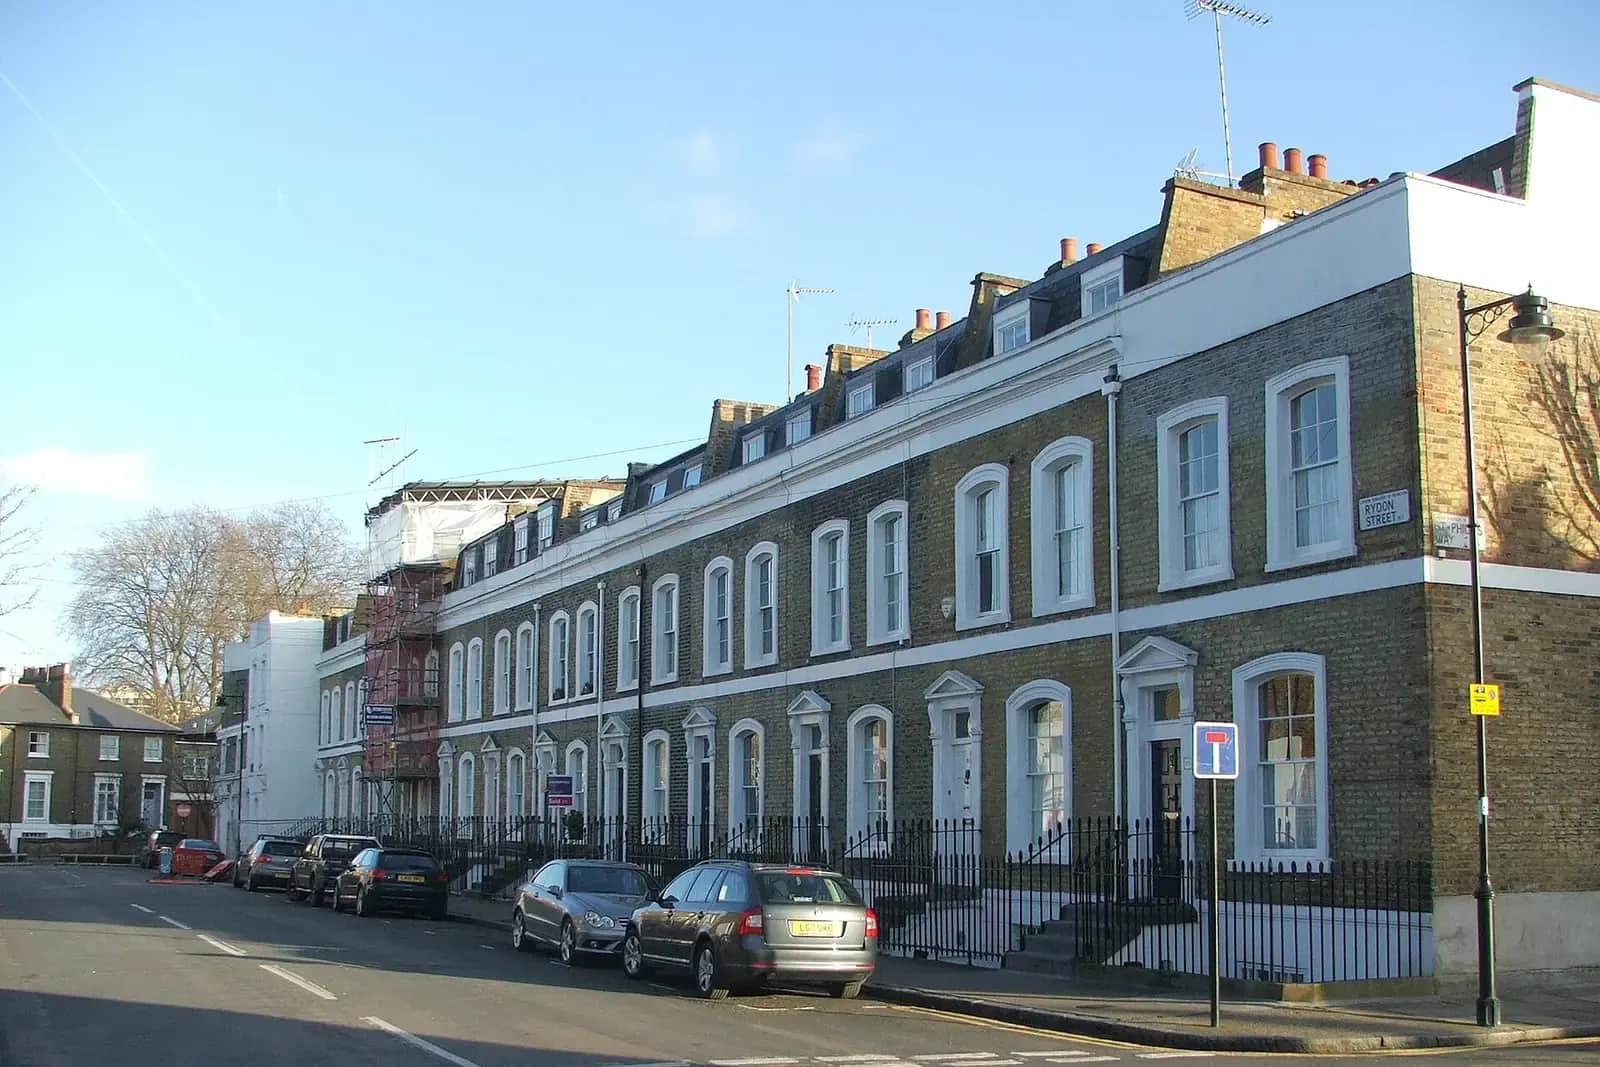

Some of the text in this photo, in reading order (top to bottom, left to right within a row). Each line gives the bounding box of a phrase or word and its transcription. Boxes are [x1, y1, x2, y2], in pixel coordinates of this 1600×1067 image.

[1365, 499, 1394, 515] RYDON
[1366, 511, 1397, 527] STREET
[1435, 535, 1455, 544] WAY
